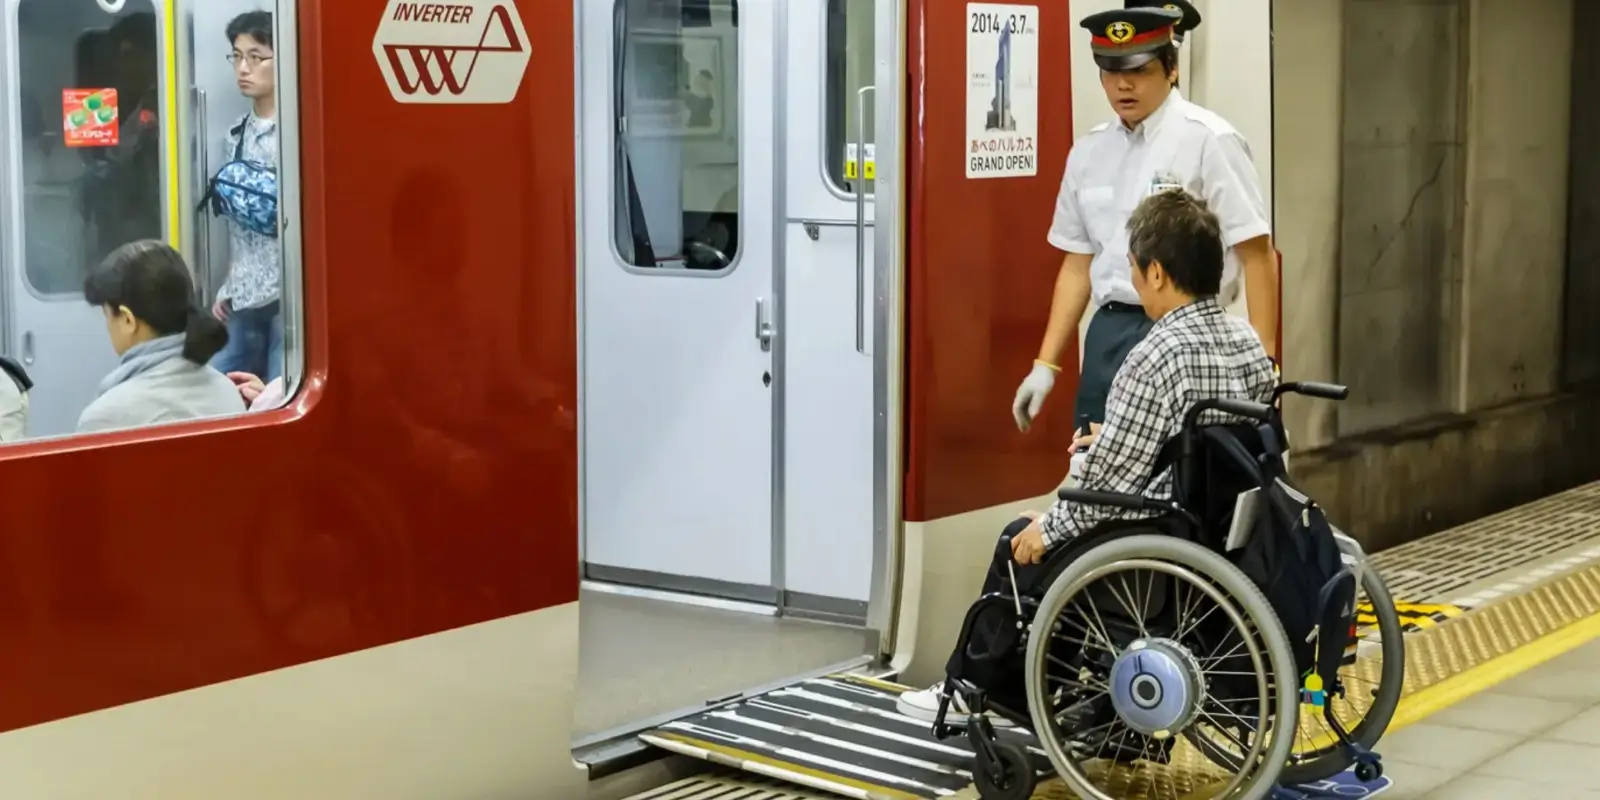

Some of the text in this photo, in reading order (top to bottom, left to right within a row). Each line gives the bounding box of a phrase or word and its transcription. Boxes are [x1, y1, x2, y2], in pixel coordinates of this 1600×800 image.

[393, 3, 473, 24] INVERTER
[971, 137, 1033, 153] あべのハルカス
[970, 155, 1034, 172] GRAND OPEN!
